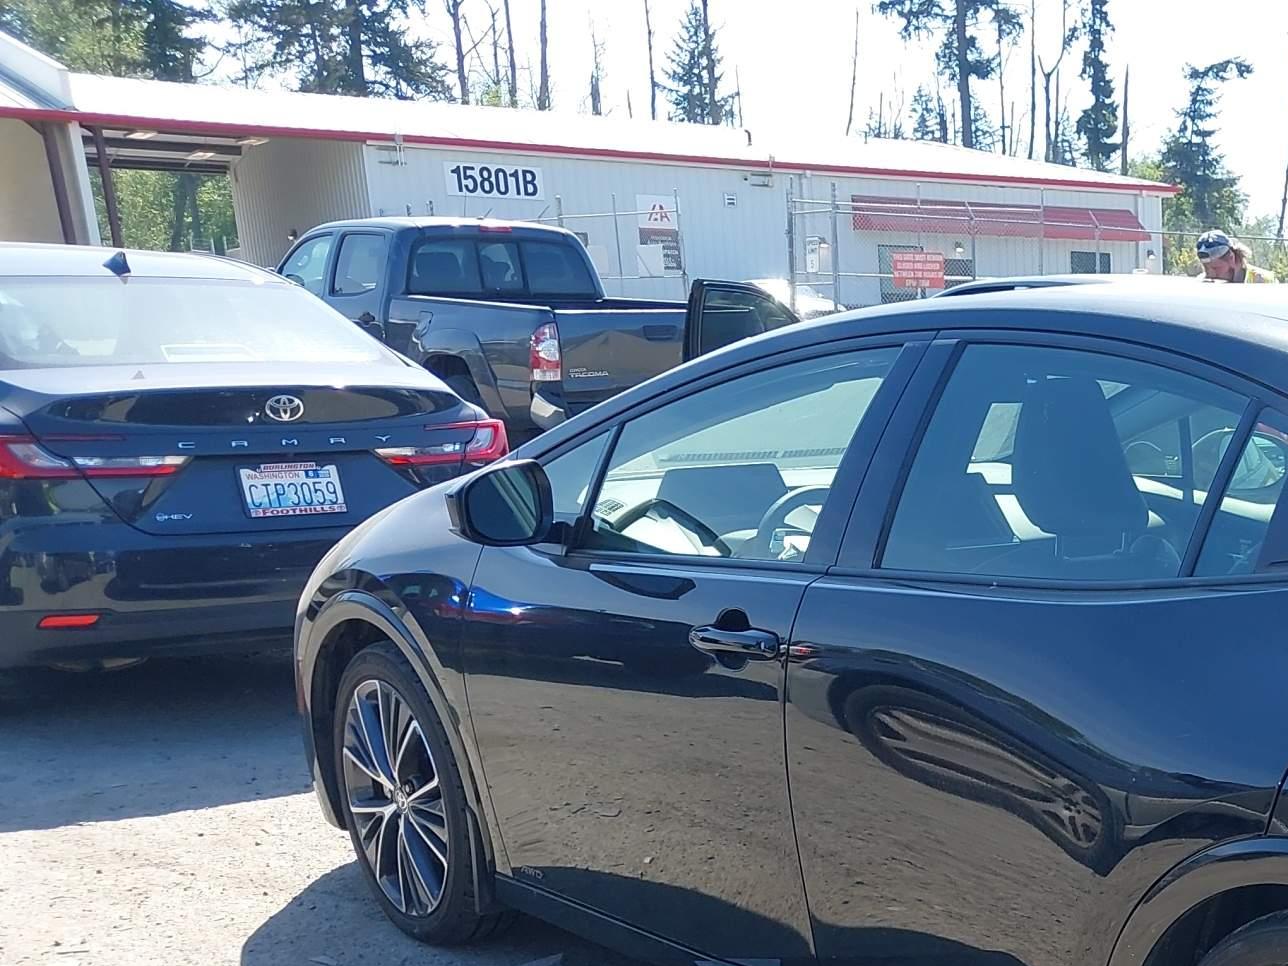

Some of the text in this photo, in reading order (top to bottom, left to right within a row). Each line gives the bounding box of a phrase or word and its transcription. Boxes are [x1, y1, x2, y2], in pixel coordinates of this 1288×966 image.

[451, 165, 538, 196] 15801B
[178, 434, 391, 449] CAMRY
[246, 472, 301, 480] WASHINGTON
[249, 481, 339, 508] CTP3059
[262, 506, 337, 516] FOOTHILLS
